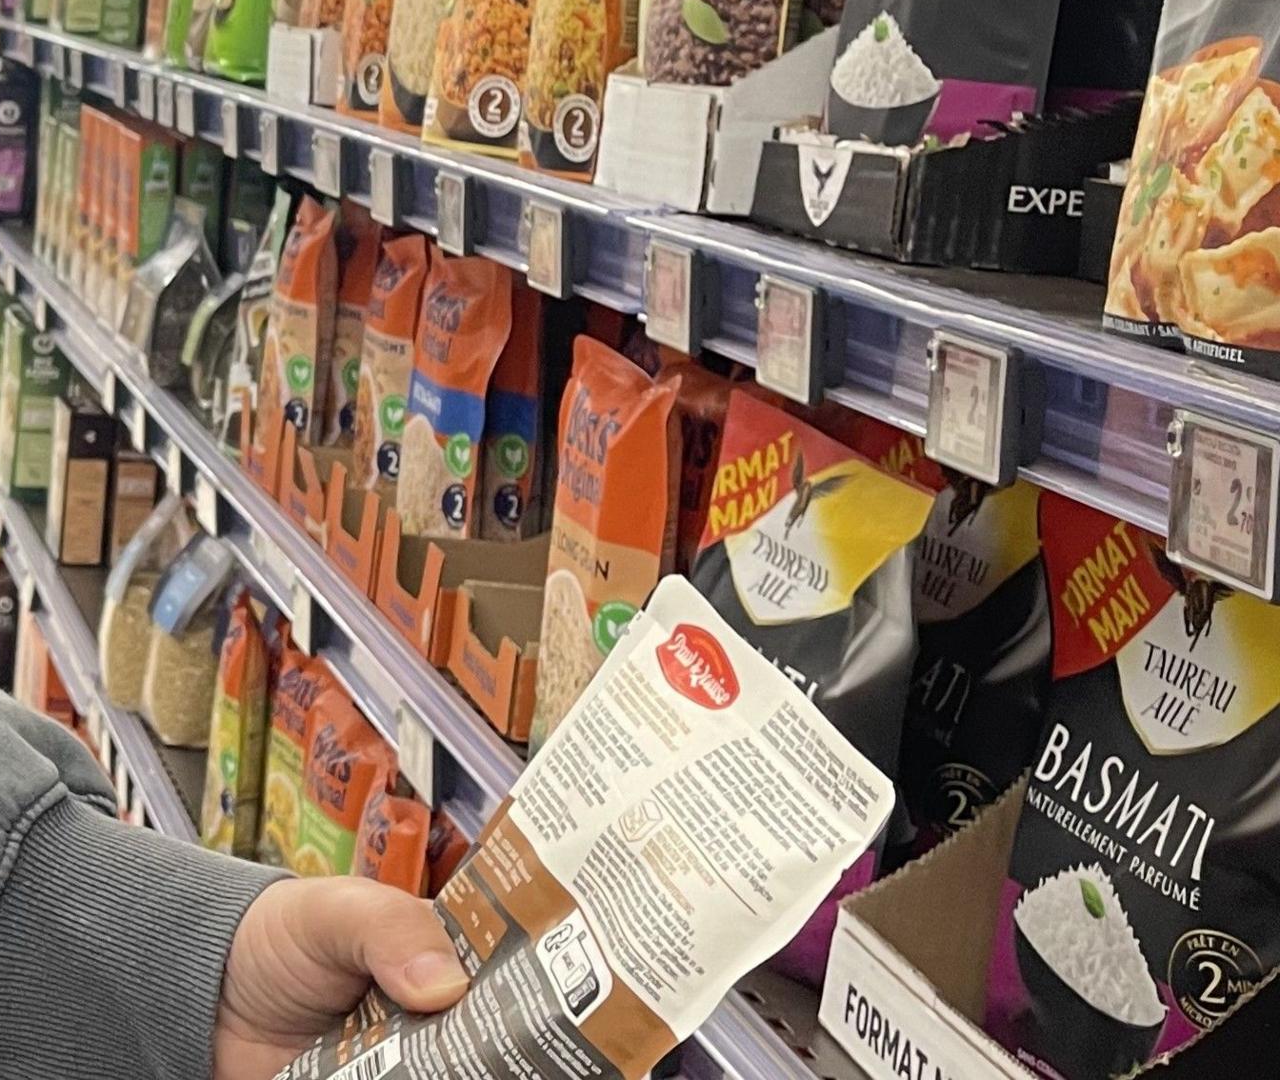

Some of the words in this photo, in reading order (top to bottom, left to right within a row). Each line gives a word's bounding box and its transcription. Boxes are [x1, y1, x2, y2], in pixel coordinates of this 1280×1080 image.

[1193, 338, 1246, 363] ARTIFICIEL
[710, 481, 778, 540] MAXI
[752, 529, 830, 594] TAUREAU
[920, 536, 989, 585] AUREAU
[1088, 573, 1152, 655] MAXI
[1144, 640, 1238, 715] TAUREAU
[1146, 690, 1202, 737] AILÉ
[1034, 722, 1216, 882] BASMATI
[1026, 785, 1128, 864] NATURELLEMENT
[1128, 855, 1201, 911] PARFUMÉ
[1219, 936, 1241, 958] EN
[1197, 959, 1227, 1005] 2
[844, 982, 929, 1080] FORMAT
